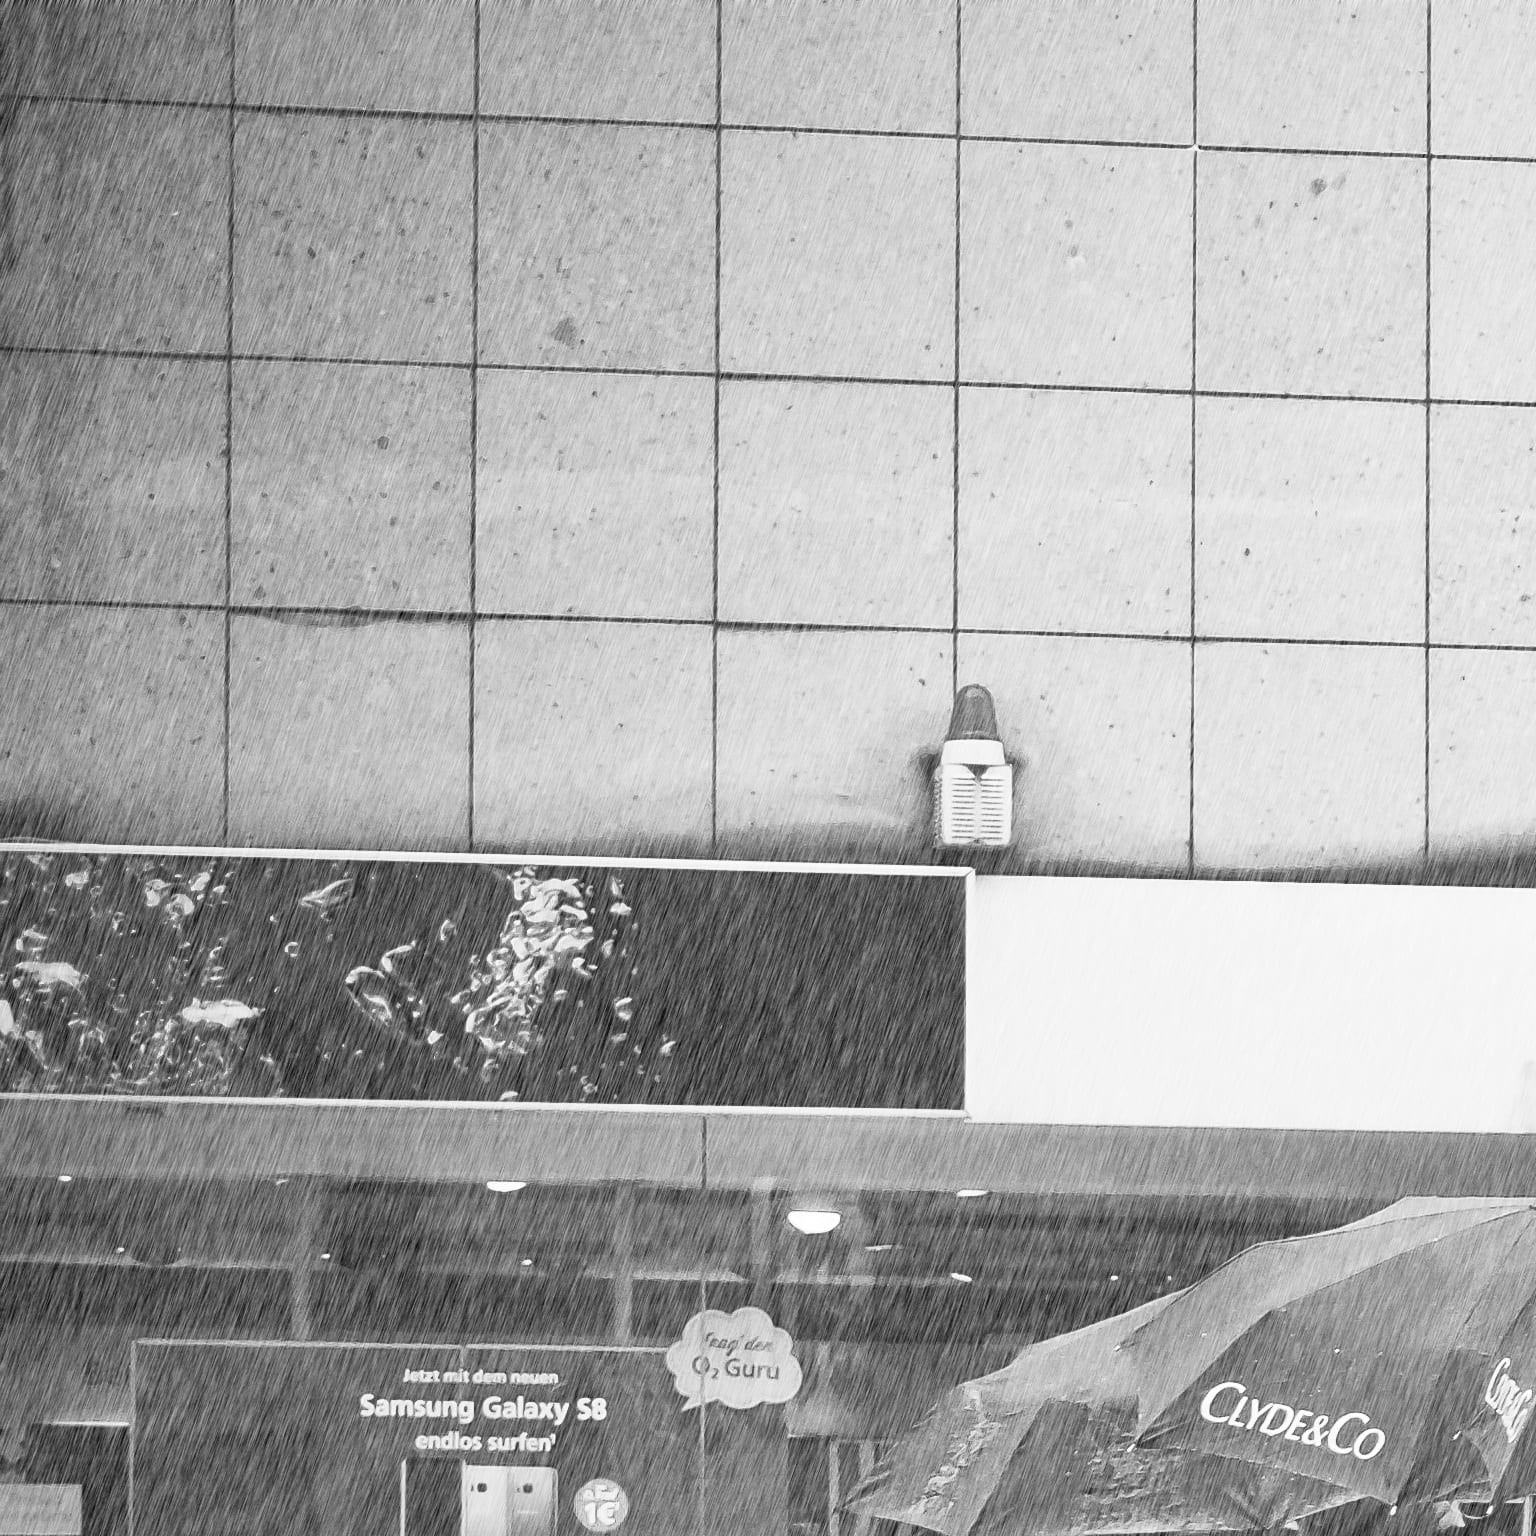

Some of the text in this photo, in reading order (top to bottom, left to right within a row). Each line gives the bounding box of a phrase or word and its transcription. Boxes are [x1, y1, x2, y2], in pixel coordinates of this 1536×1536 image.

[403, 1368, 559, 1385] Jetzt mit dem neuen
[724, 1358, 780, 1380] Guru
[360, 1393, 608, 1426] Samsung Galaxy S8
[415, 1430, 483, 1451] endlos
